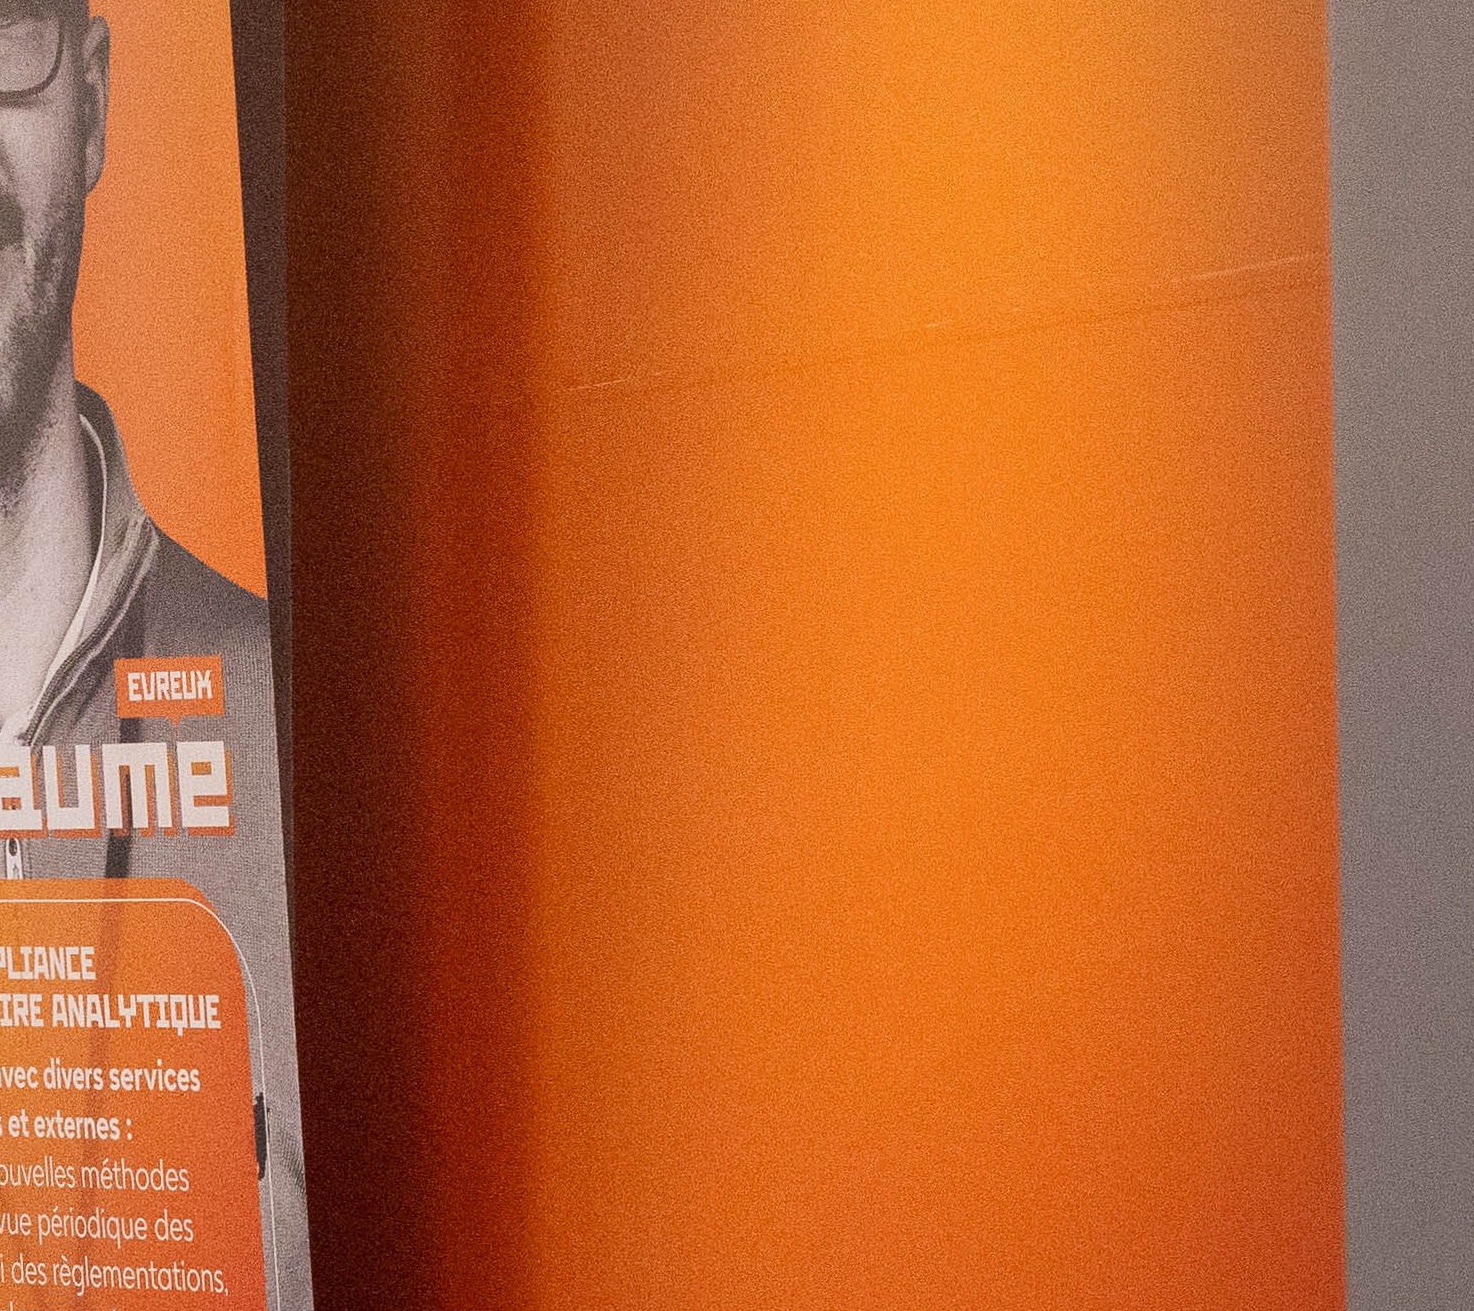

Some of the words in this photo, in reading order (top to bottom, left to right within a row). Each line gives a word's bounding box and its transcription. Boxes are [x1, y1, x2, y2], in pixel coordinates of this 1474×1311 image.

[128, 670, 212, 702] EVREUX
[52, 995, 221, 1036] ANALYTIQUE
[43, 1056, 104, 1091] divers
[109, 1059, 200, 1092] services
[8, 1108, 30, 1138] et
[34, 1110, 120, 1141] externes
[127, 1121, 133, 1139] :
[81, 1158, 189, 1192] méthodes
[37, 1206, 148, 1247] périodique
[154, 1212, 194, 1242] des
[11, 1253, 47, 1285] des
[52, 1255, 229, 1296] règlementations,
